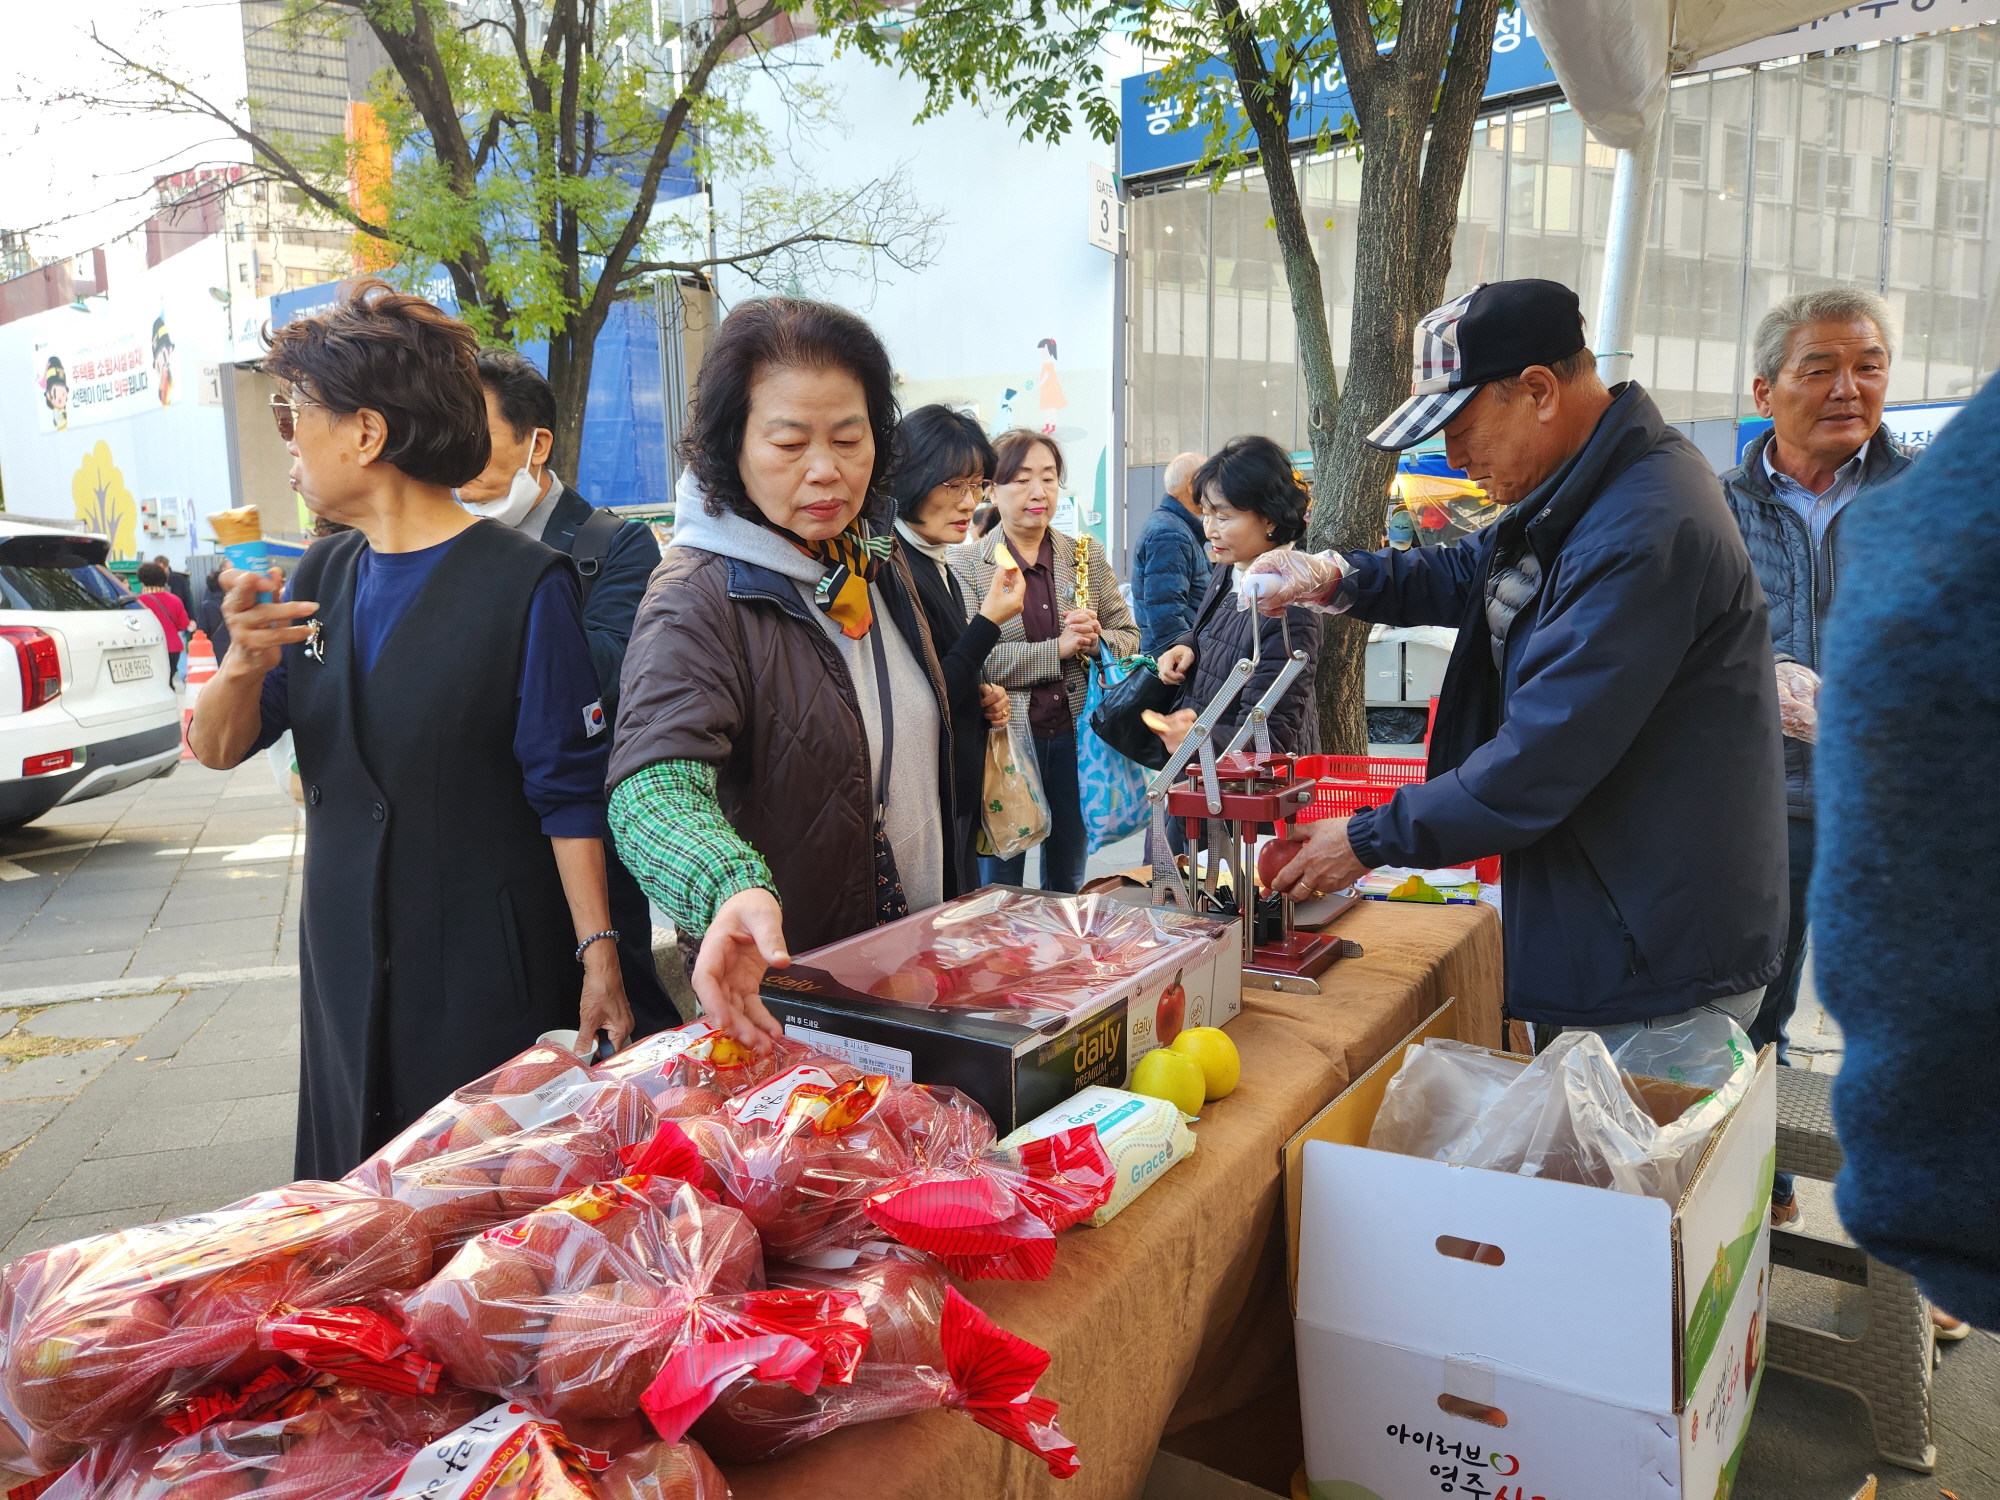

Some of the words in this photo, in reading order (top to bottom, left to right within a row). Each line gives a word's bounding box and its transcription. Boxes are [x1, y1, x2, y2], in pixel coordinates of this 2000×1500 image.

[1096, 179, 1113, 198] GATE
[1100, 198, 1109, 234] 3
[72, 361, 95, 383] 주택용
[97, 354, 128, 378] 소방시설
[128, 348, 144, 370] 설치!
[203, 366, 219, 377] GAT
[72, 383, 95, 408] 선택이
[96, 378, 113, 402] 아닌
[114, 370, 149, 398] 의무입니다
[211, 378, 219, 398] 1
[97, 636, 164, 648] PALISADE
[765, 975, 823, 991] daily
[1190, 1003, 1203, 1020] daily
[1132, 1016, 1153, 1036] daily
[1073, 1021, 1121, 1073] daily
[1075, 1060, 1107, 1092] PREMIUM
[1068, 1102, 1108, 1126] Grace
[1131, 1149, 1166, 1185] Grace
[513, 1437, 525, 1447] &
[1387, 1424, 1489, 1468] 아이러브
[469, 1446, 516, 1500] DELICIOU
[1430, 1465, 1492, 1500] 영주
